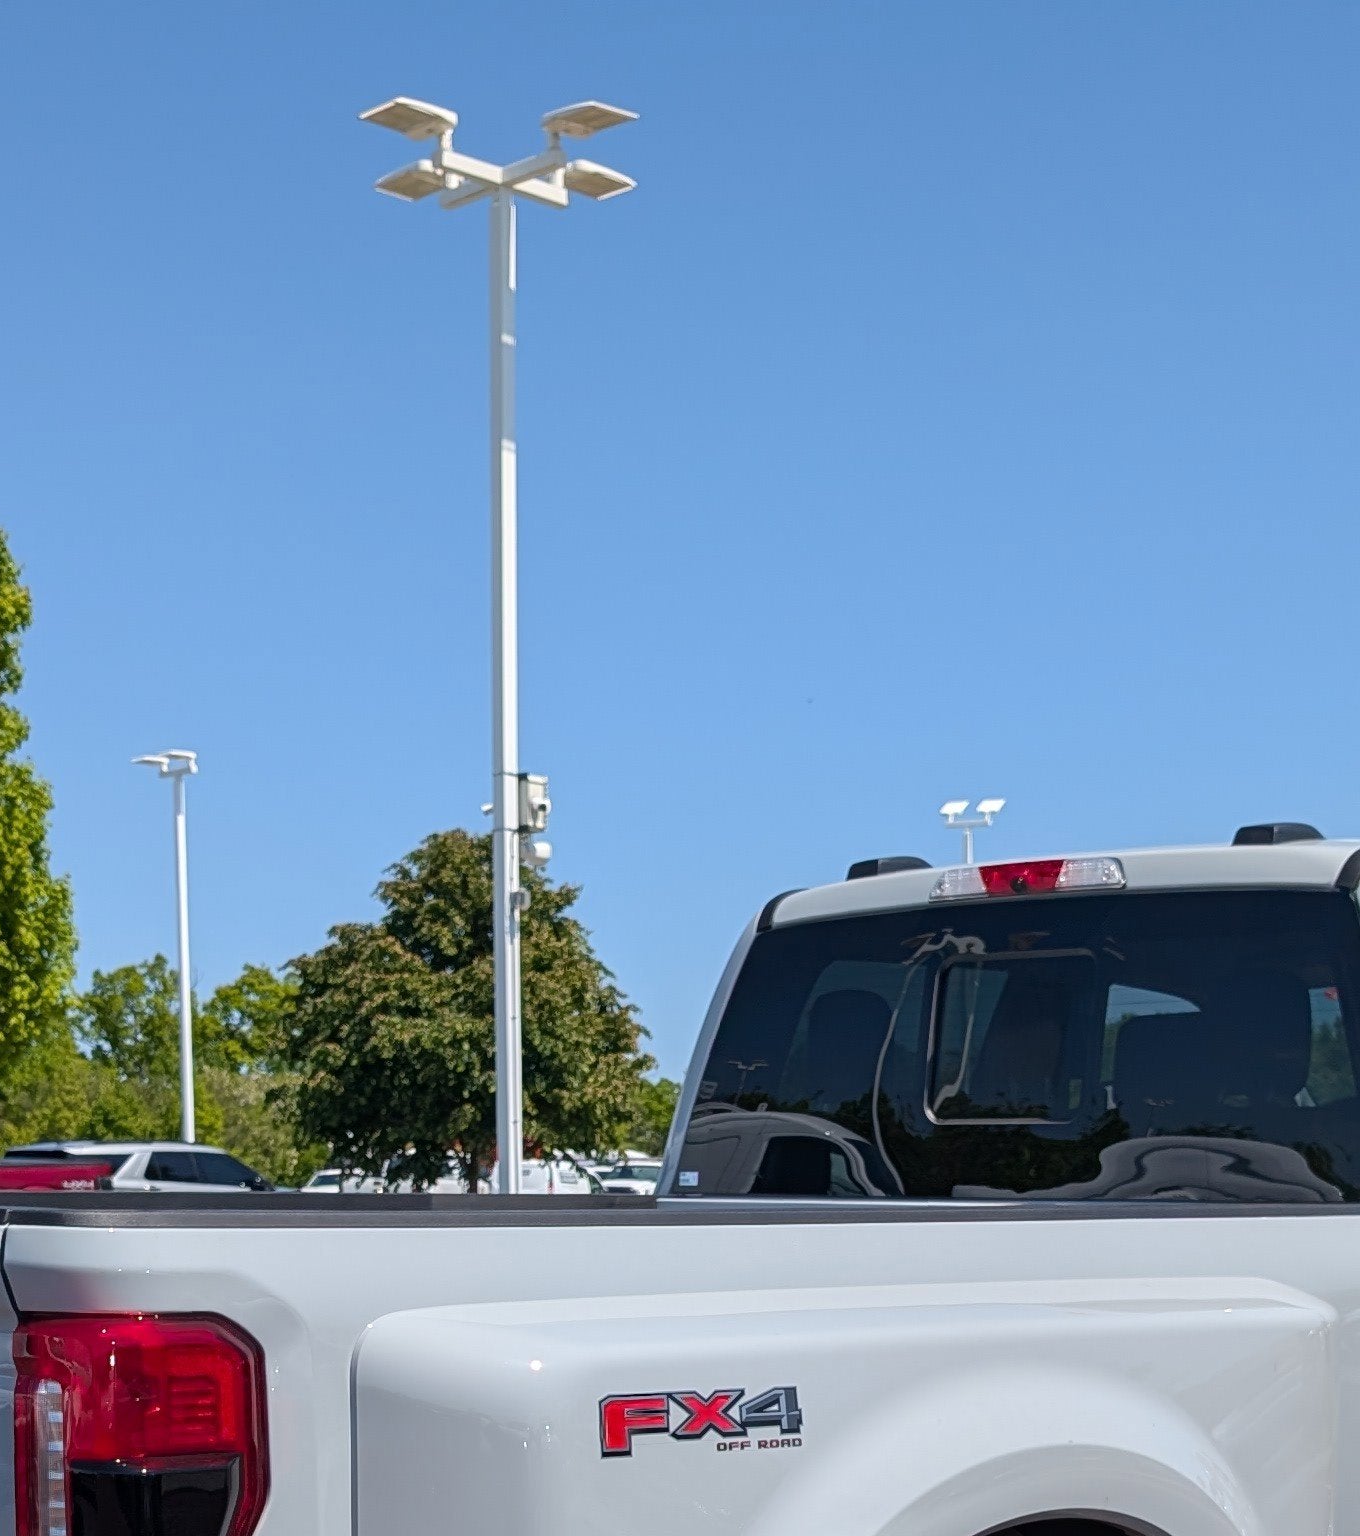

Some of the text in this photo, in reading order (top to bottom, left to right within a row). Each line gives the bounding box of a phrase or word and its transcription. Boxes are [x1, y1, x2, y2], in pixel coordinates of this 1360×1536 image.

[599, 1385, 803, 1459] FX4
[716, 1437, 803, 1452] OFF ROAD
